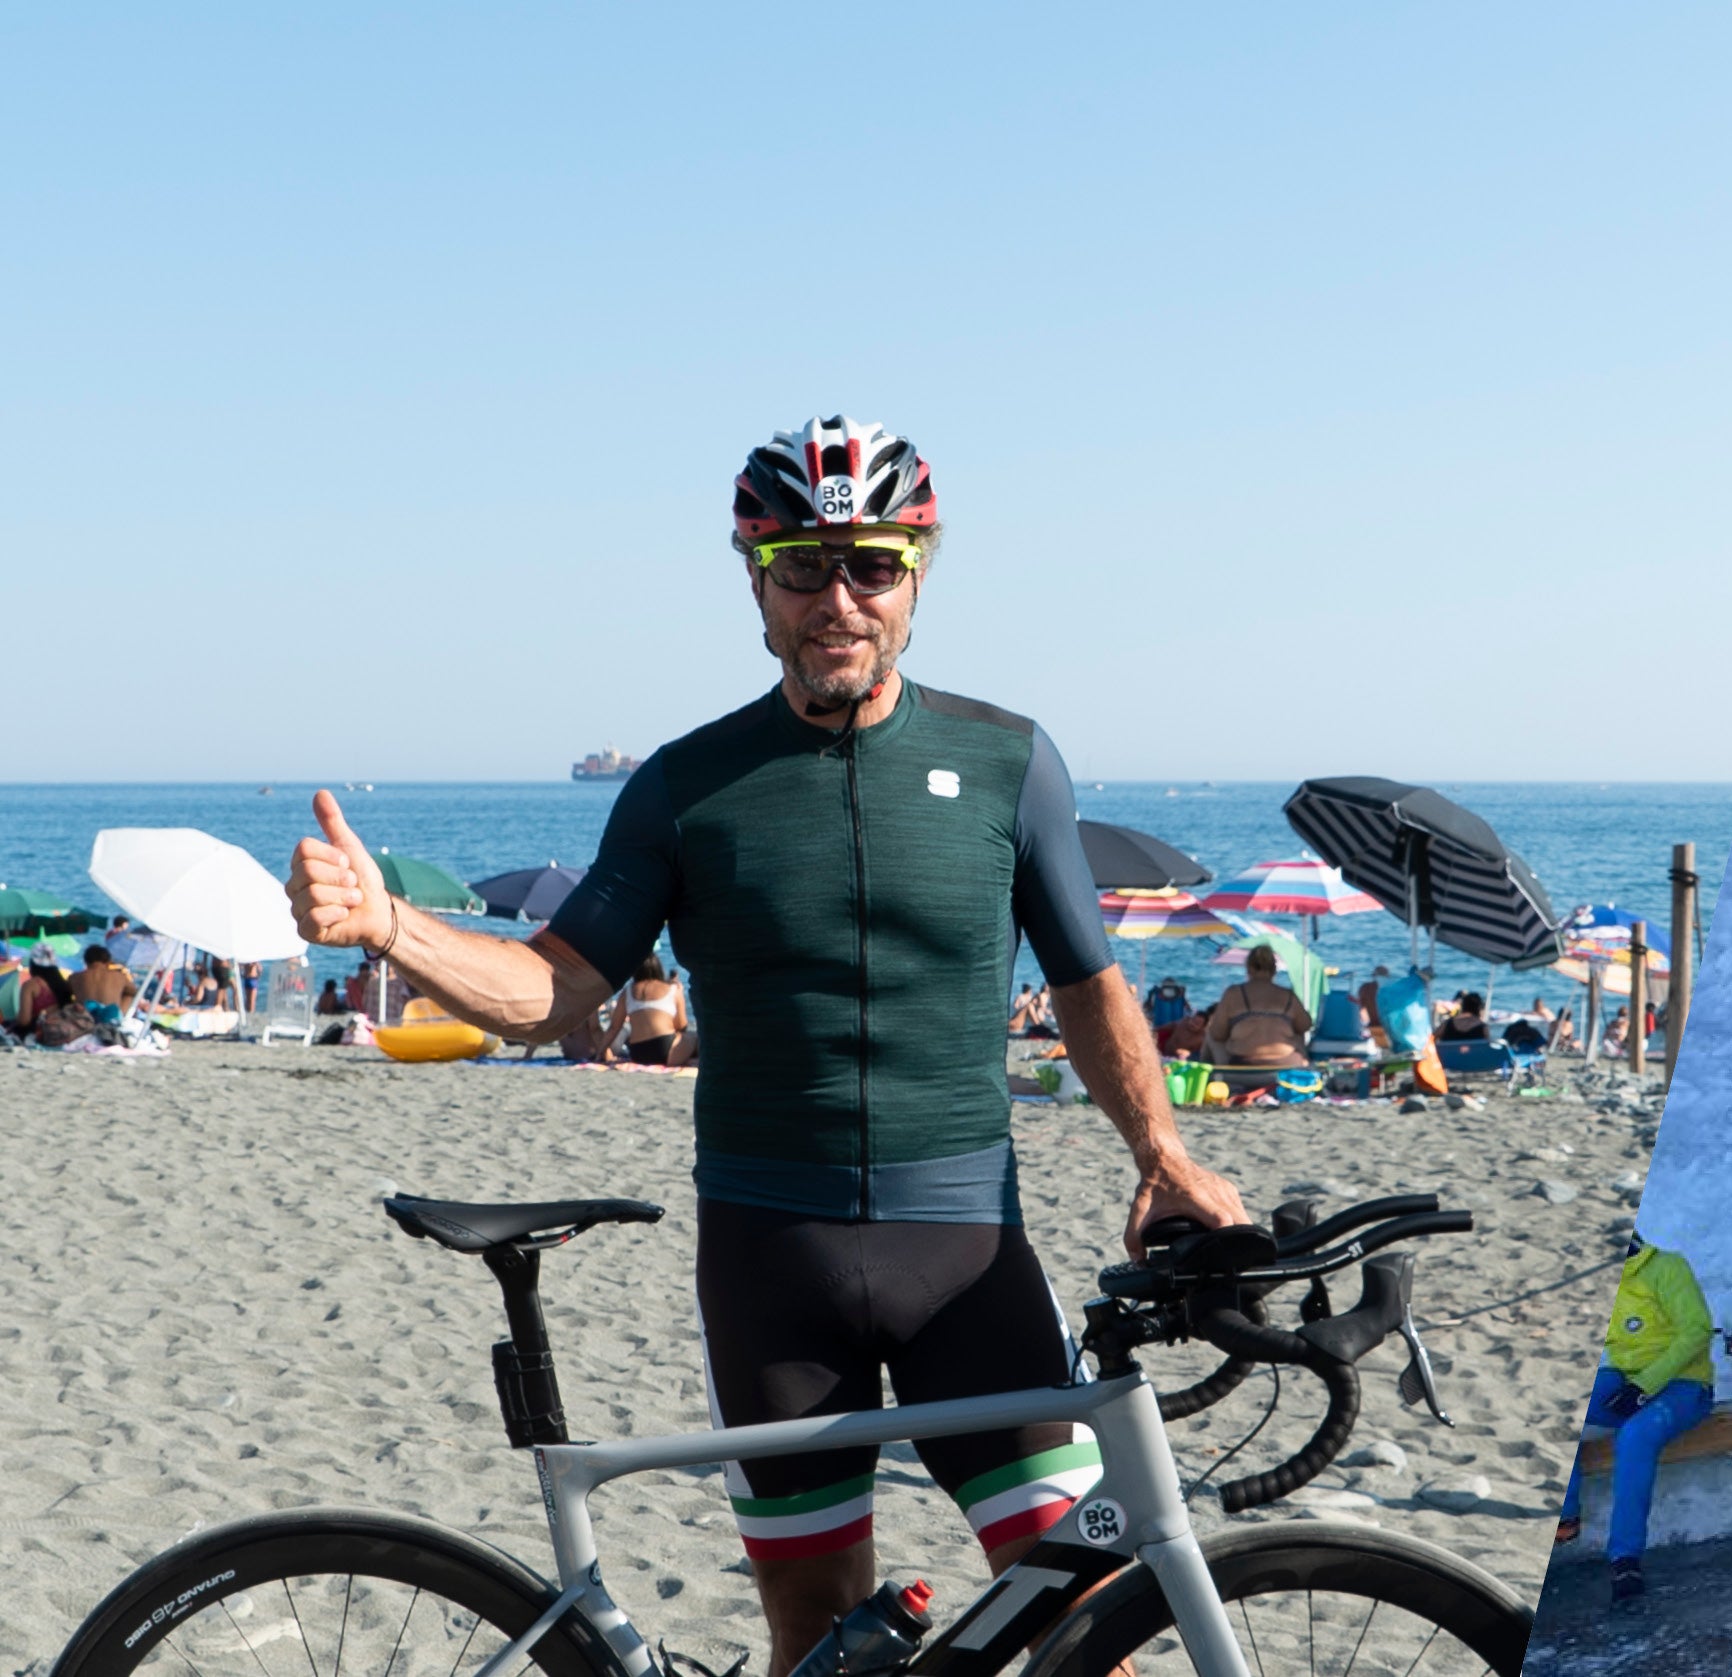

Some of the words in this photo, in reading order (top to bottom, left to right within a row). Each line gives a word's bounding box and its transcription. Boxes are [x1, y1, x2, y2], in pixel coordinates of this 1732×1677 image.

[822, 483, 853, 499] BO
[822, 499, 854, 515] OM
[1084, 1506, 1116, 1526] BO
[1087, 1521, 1120, 1540] OM
[151, 1600, 176, 1624] 46
[124, 1619, 153, 1649] DISC
